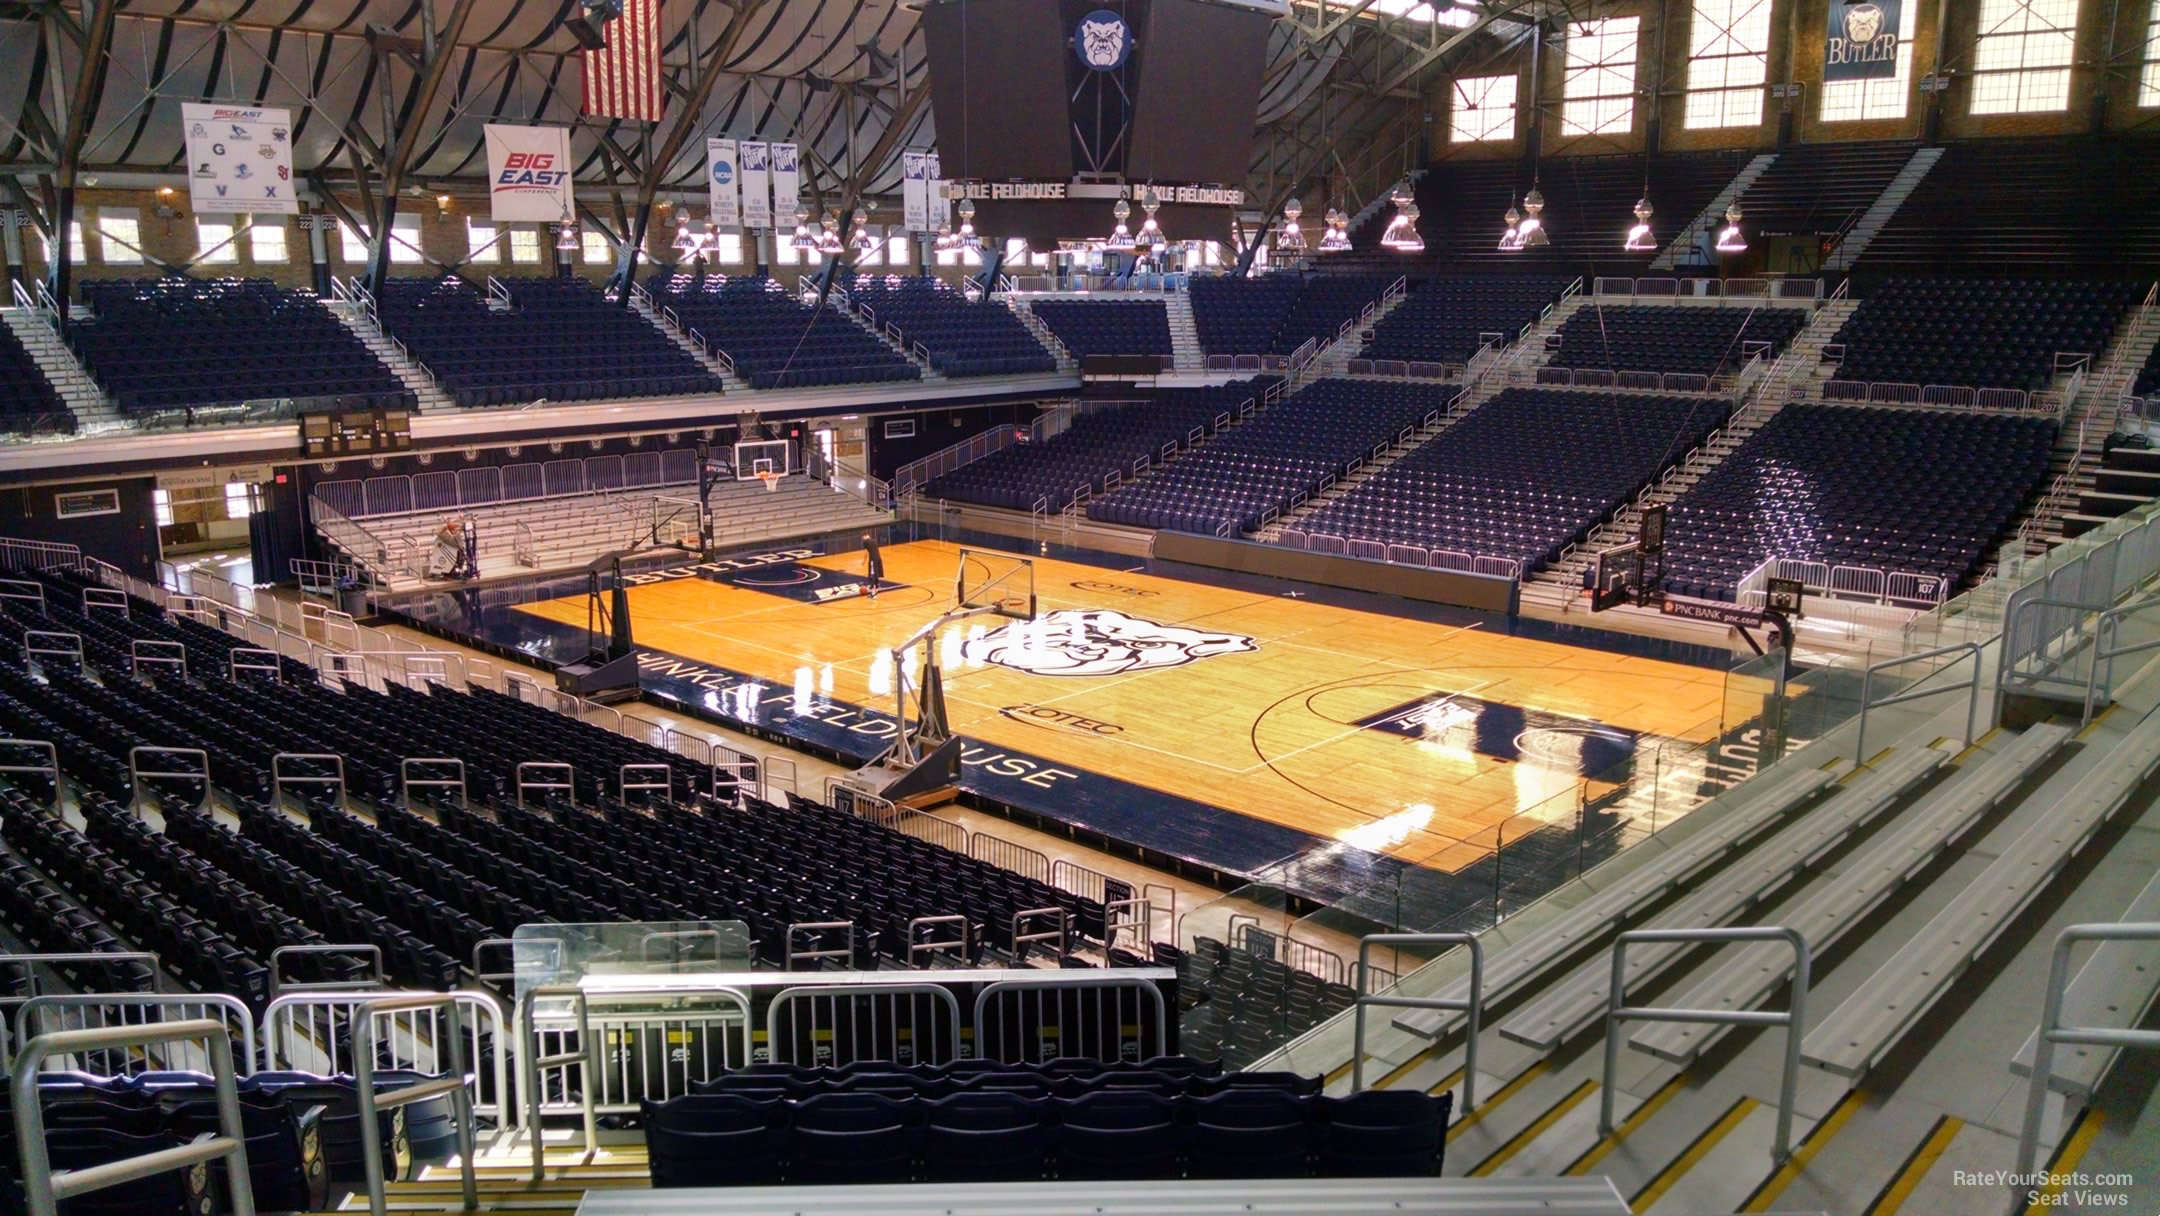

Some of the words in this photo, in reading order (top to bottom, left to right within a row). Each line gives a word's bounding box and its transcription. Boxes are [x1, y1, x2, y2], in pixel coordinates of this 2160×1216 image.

[1827, 33, 1896, 64] BUTLER
[214, 109, 235, 117] BIG
[234, 110, 263, 118] EAST
[212, 143, 225, 156] G
[504, 152, 555, 169] BIG
[497, 169, 568, 186] EAST
[216, 185, 227, 197] V
[265, 186, 277, 198] X
[992, 182, 1066, 199] FIELDHOUSE
[1135, 184, 1175, 202] HKLE
[1178, 186, 1240, 204] FIELDHOUSE
[1791, 390, 1805, 398] 207
[2040, 403, 2057, 412] 207
[622, 547, 826, 586] BUTLER
[1918, 583, 1935, 594] 107
[1674, 606, 1694, 617] PNC
[1694, 606, 1721, 619] BANK
[1723, 614, 1759, 626] pnc.com
[1105, 881, 1130, 894] SECTION
